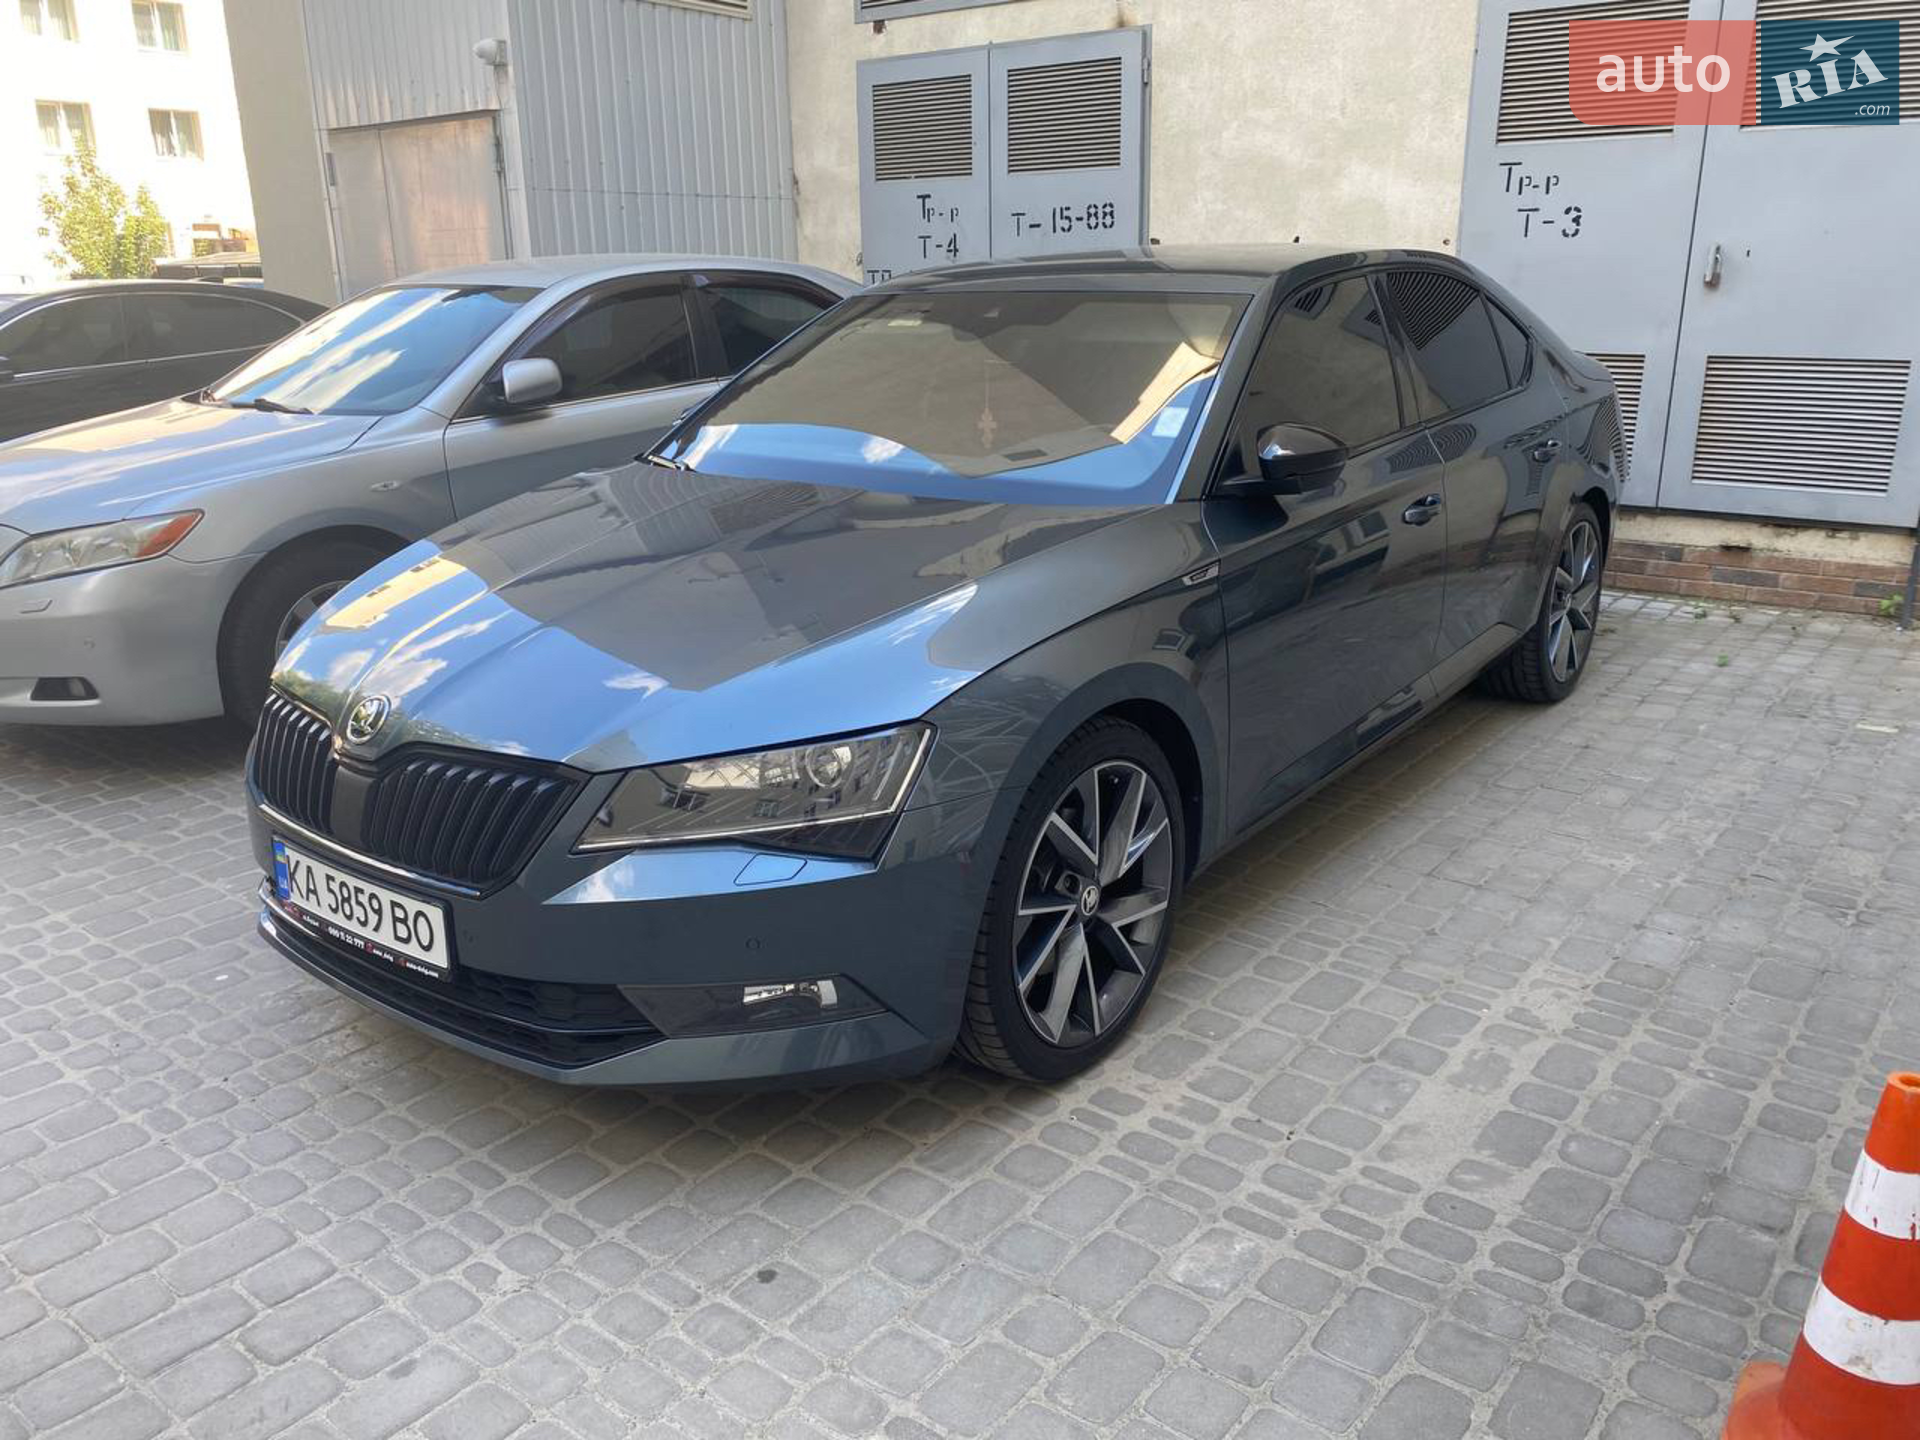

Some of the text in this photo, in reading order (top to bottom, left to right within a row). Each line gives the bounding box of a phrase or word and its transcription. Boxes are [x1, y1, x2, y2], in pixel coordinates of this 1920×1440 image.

[286, 854, 435, 953] KA 5859 BO
